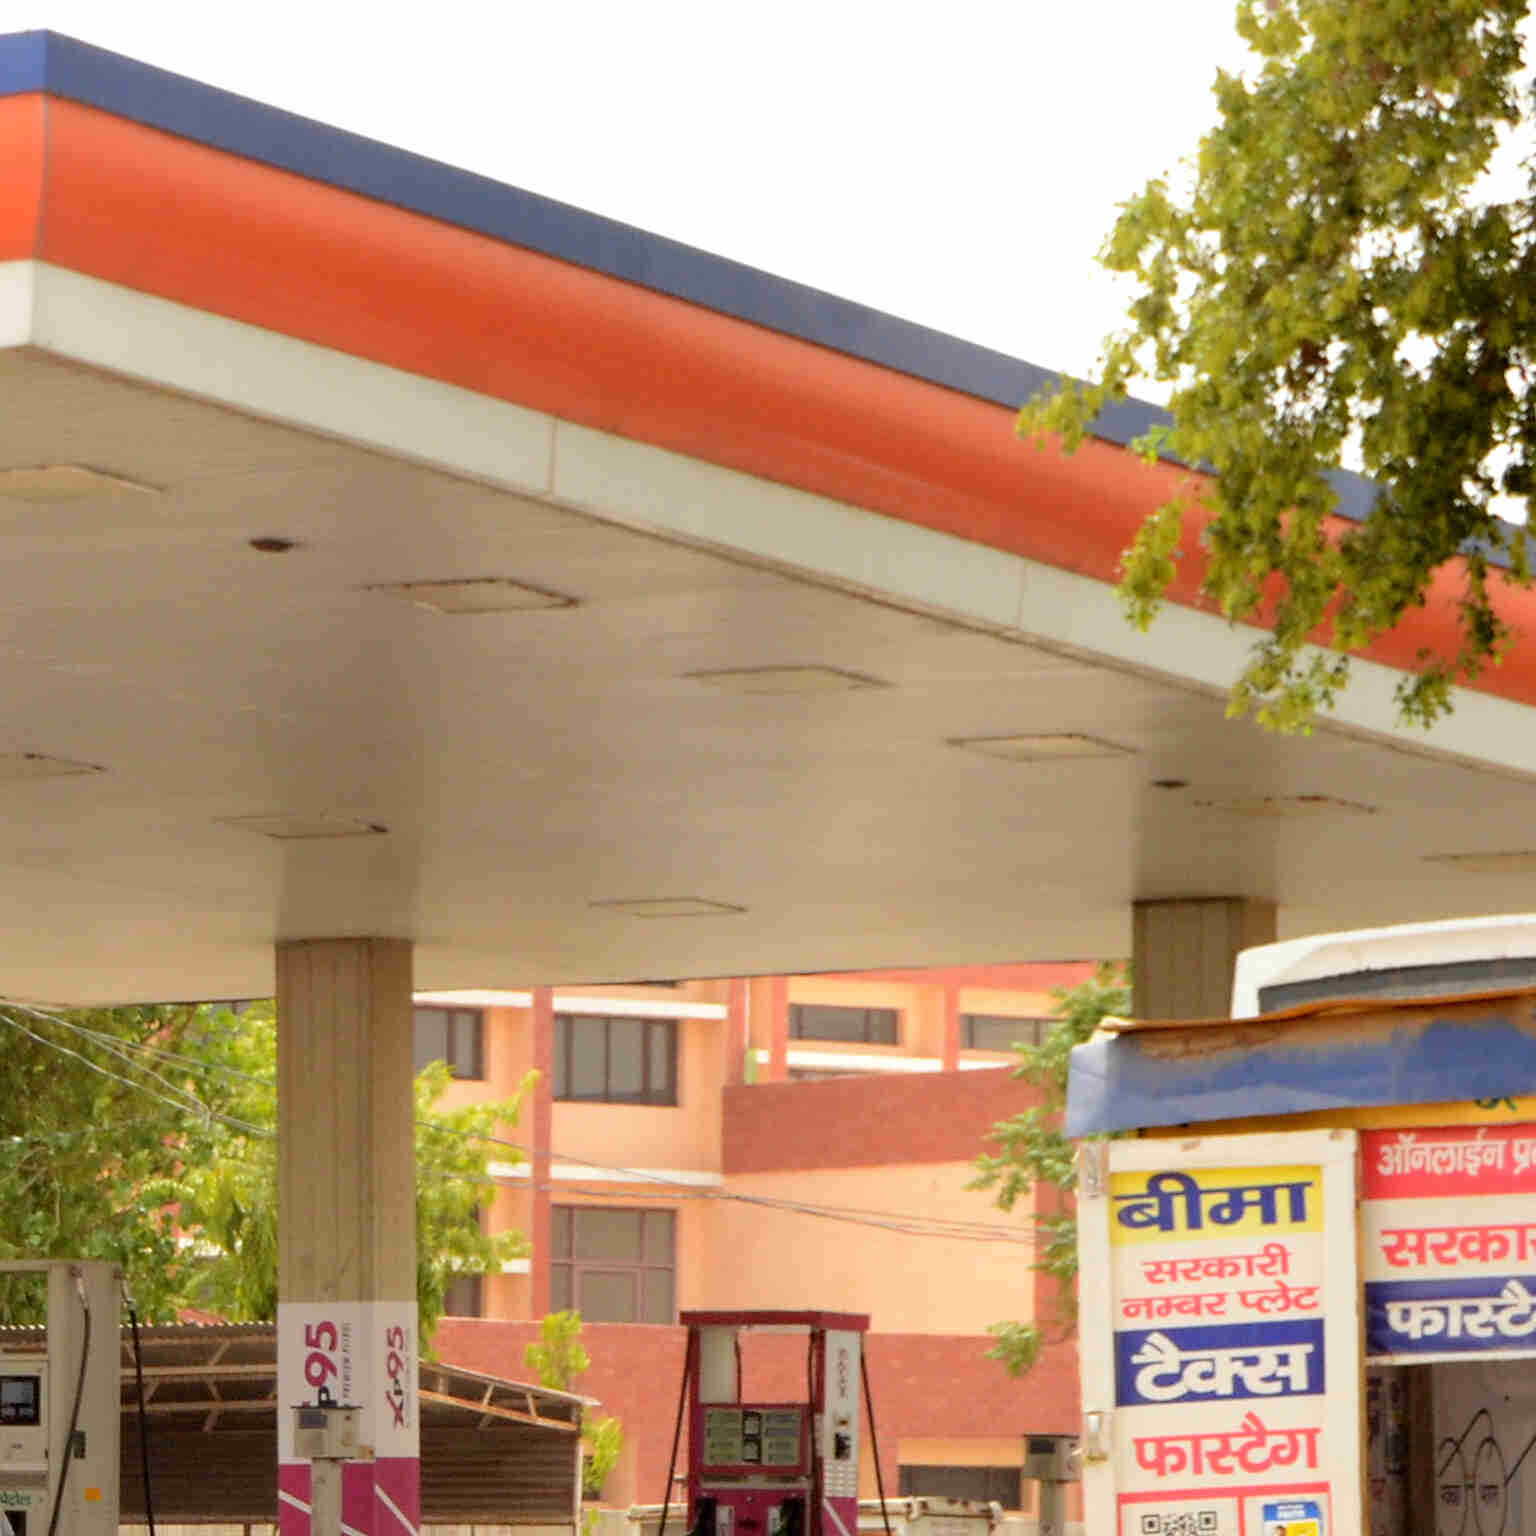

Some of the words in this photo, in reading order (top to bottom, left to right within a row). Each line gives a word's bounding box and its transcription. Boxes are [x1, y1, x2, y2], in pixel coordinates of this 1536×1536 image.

[1113, 1171, 1313, 1232] बीमा
[1143, 1242, 1292, 1285] सरकारी
[1381, 1223, 1536, 1268] सरका
[1121, 1292, 1229, 1321] नम्बर
[1237, 1279, 1321, 1314] प्लेट
[1384, 1278, 1536, 1340] फास्टै
[302, 1320, 338, 1407] P95
[1131, 1331, 1315, 1402] टैक्स
[1132, 1411, 1321, 1477] फास्टैग
